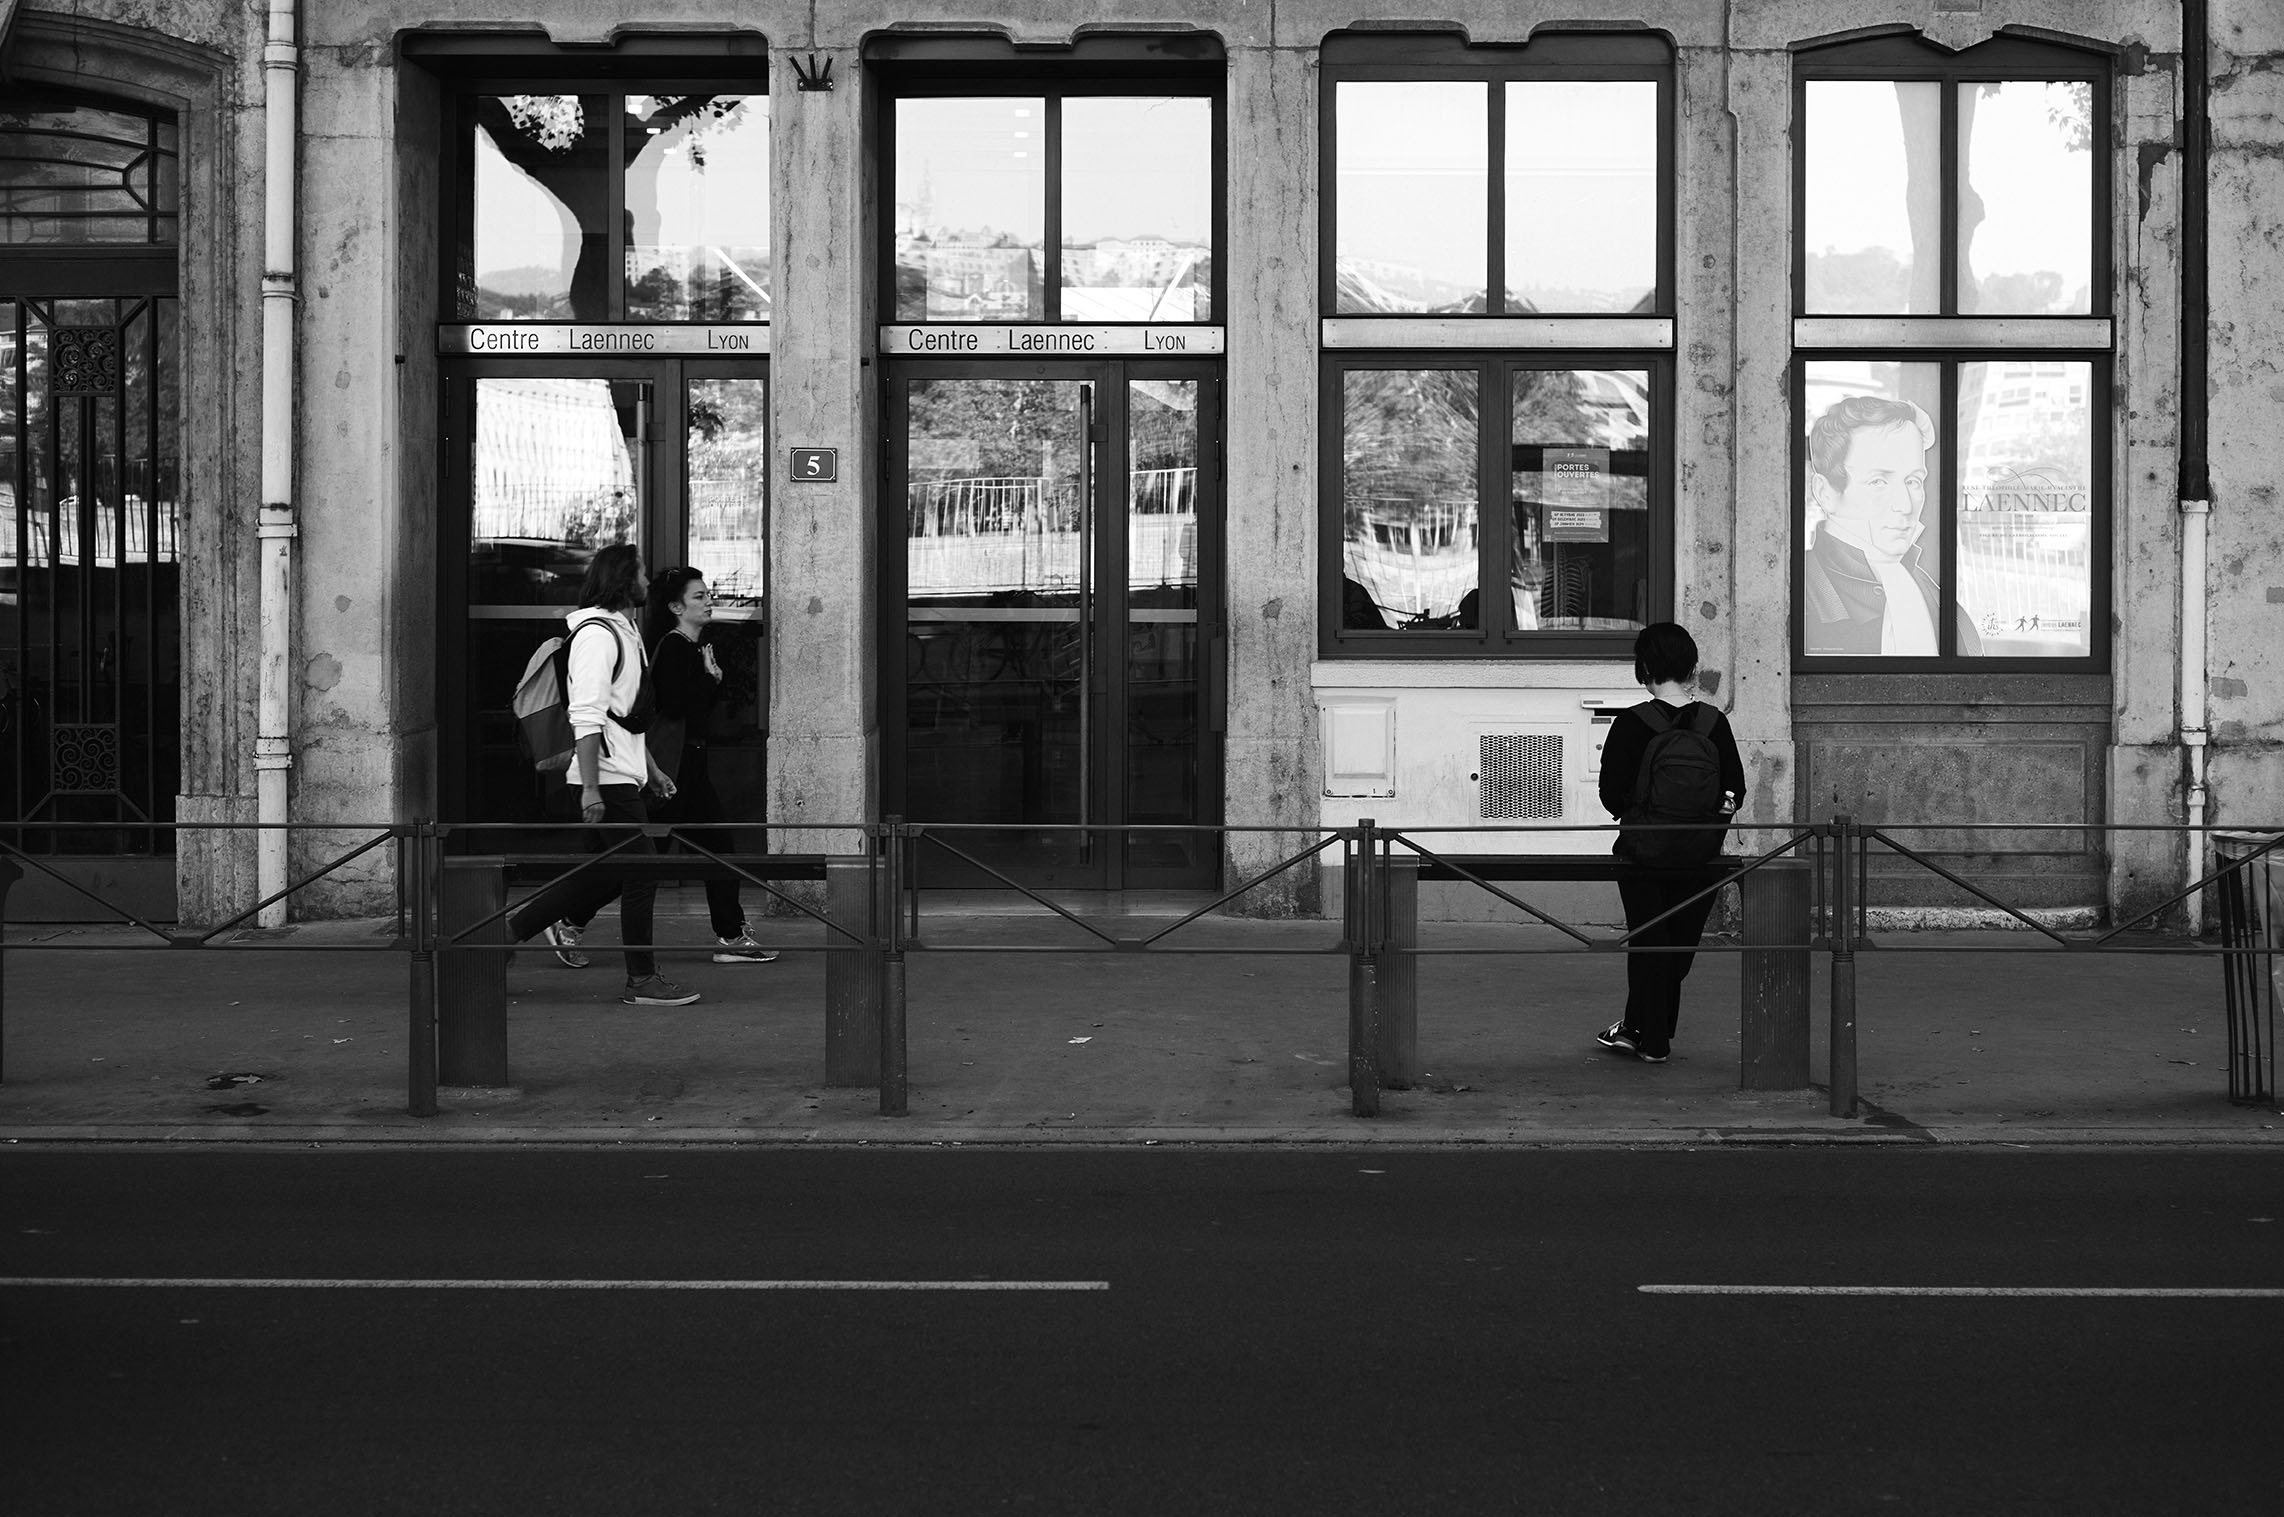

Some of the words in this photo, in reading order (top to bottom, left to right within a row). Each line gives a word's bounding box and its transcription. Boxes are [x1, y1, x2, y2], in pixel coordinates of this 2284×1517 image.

[470, 328, 539, 350] Centre
[569, 328, 655, 350] Laennec
[908, 328, 978, 350] Centre
[1009, 328, 1095, 350] Laennec
[806, 455, 821, 476] 5
[1557, 471, 1600, 479] OUVERTES
[1963, 493, 2086, 512] LAENNEC
